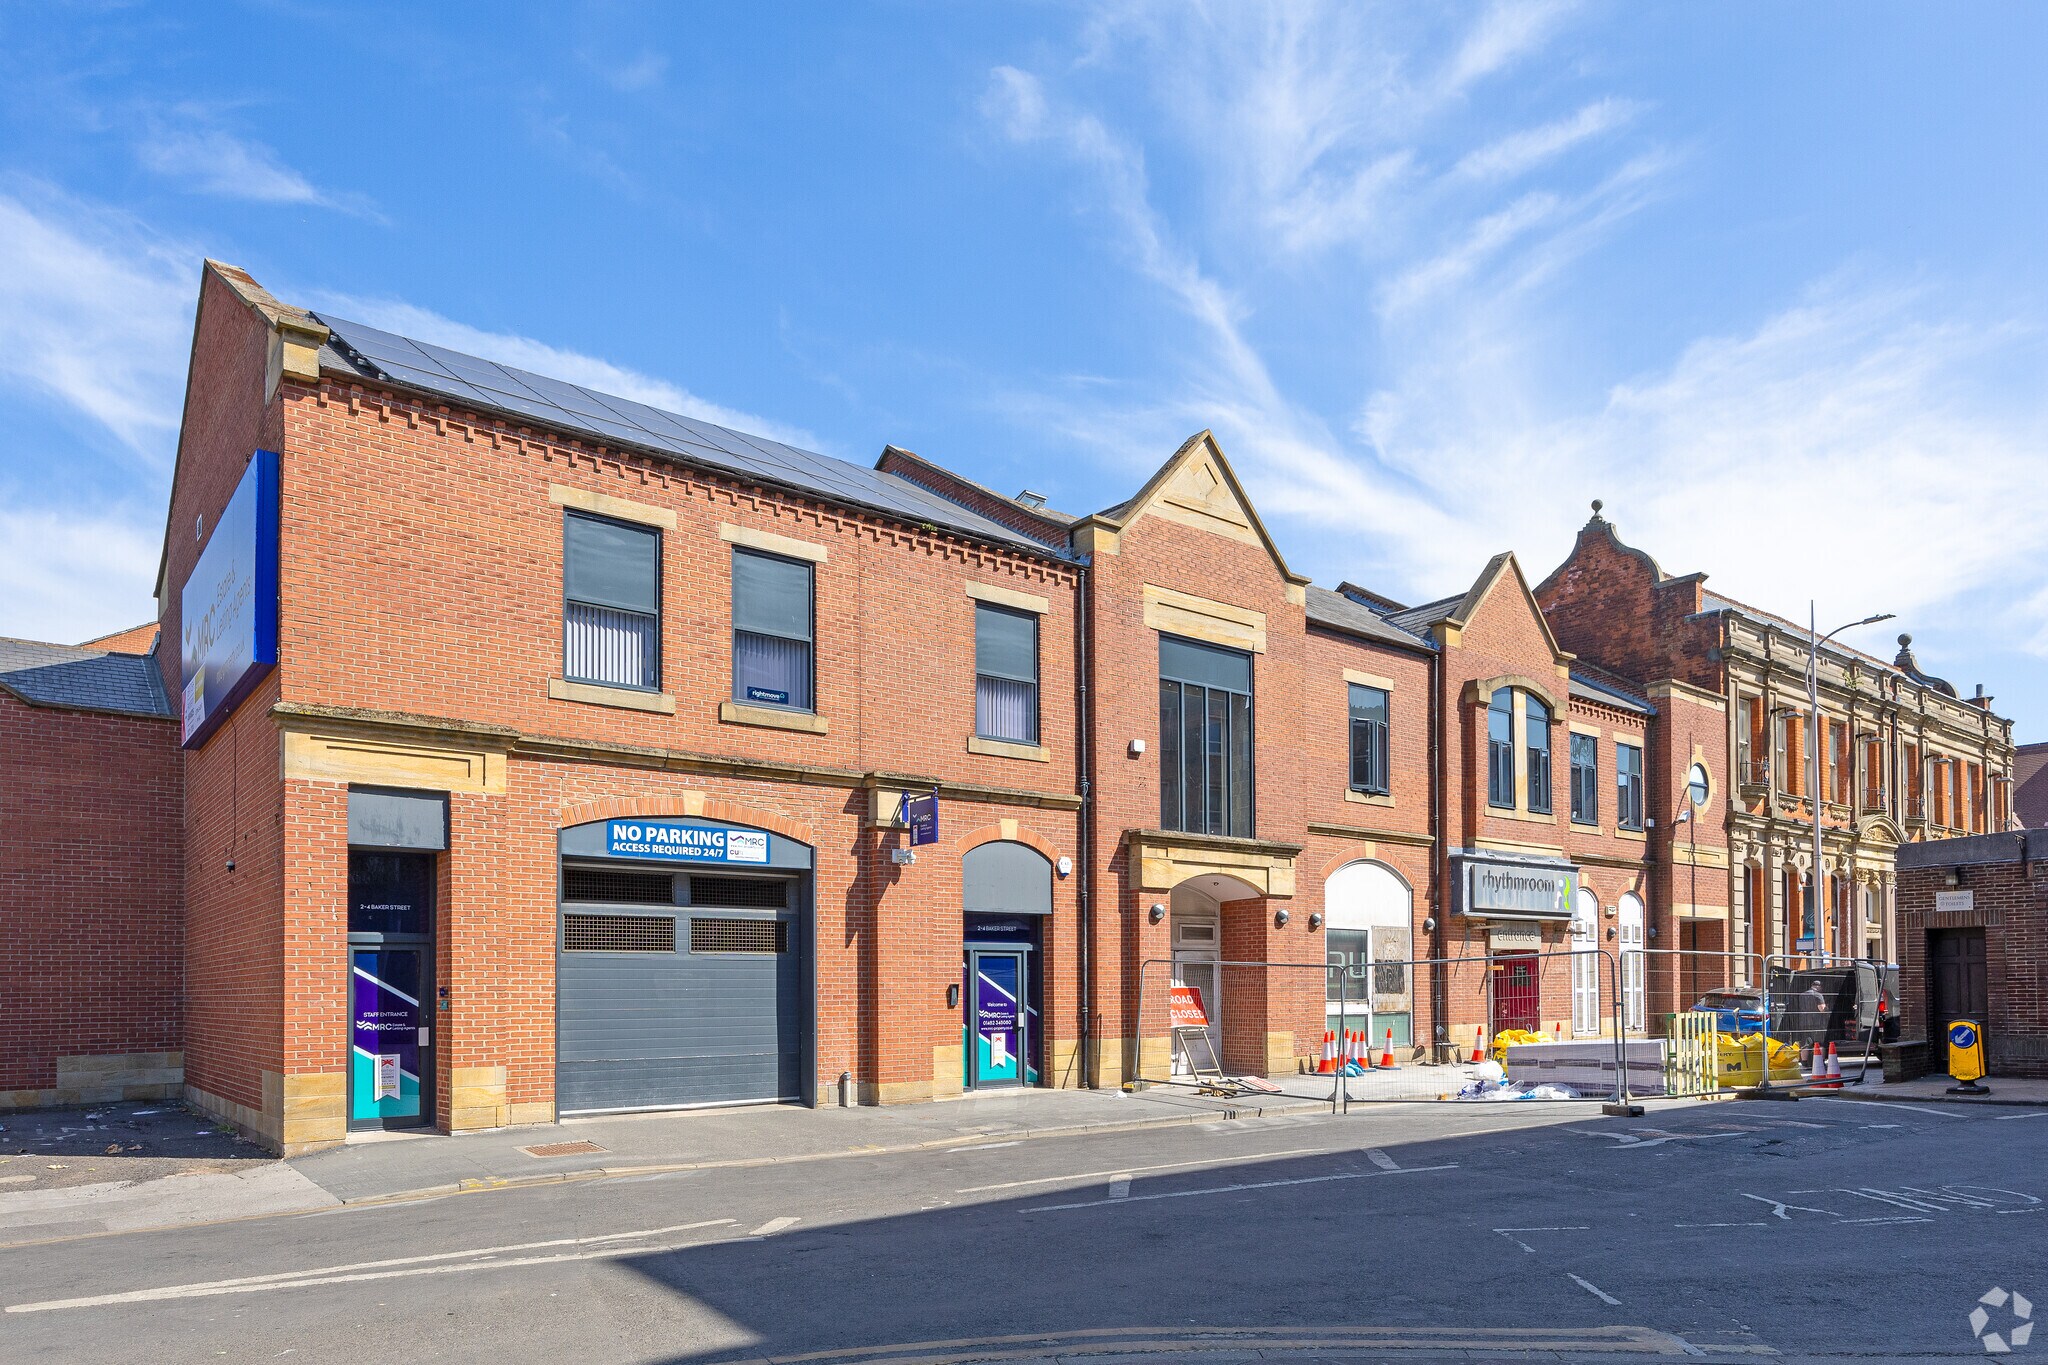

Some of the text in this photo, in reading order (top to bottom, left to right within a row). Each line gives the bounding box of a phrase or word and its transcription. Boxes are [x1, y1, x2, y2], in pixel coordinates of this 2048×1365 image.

[752, 690, 780, 699] rightmove
[613, 824, 725, 847] NO PARKING
[745, 837, 764, 846] MRC
[612, 842, 724, 858] ACCESS REQUIRED 24/7
[1482, 870, 1555, 893] rhythmroom
[1498, 929, 1536, 941] entrance
[1170, 994, 1194, 1004] ROAD
[1170, 1009, 1205, 1019] CLOSED
[372, 1023, 392, 1031] MRC
